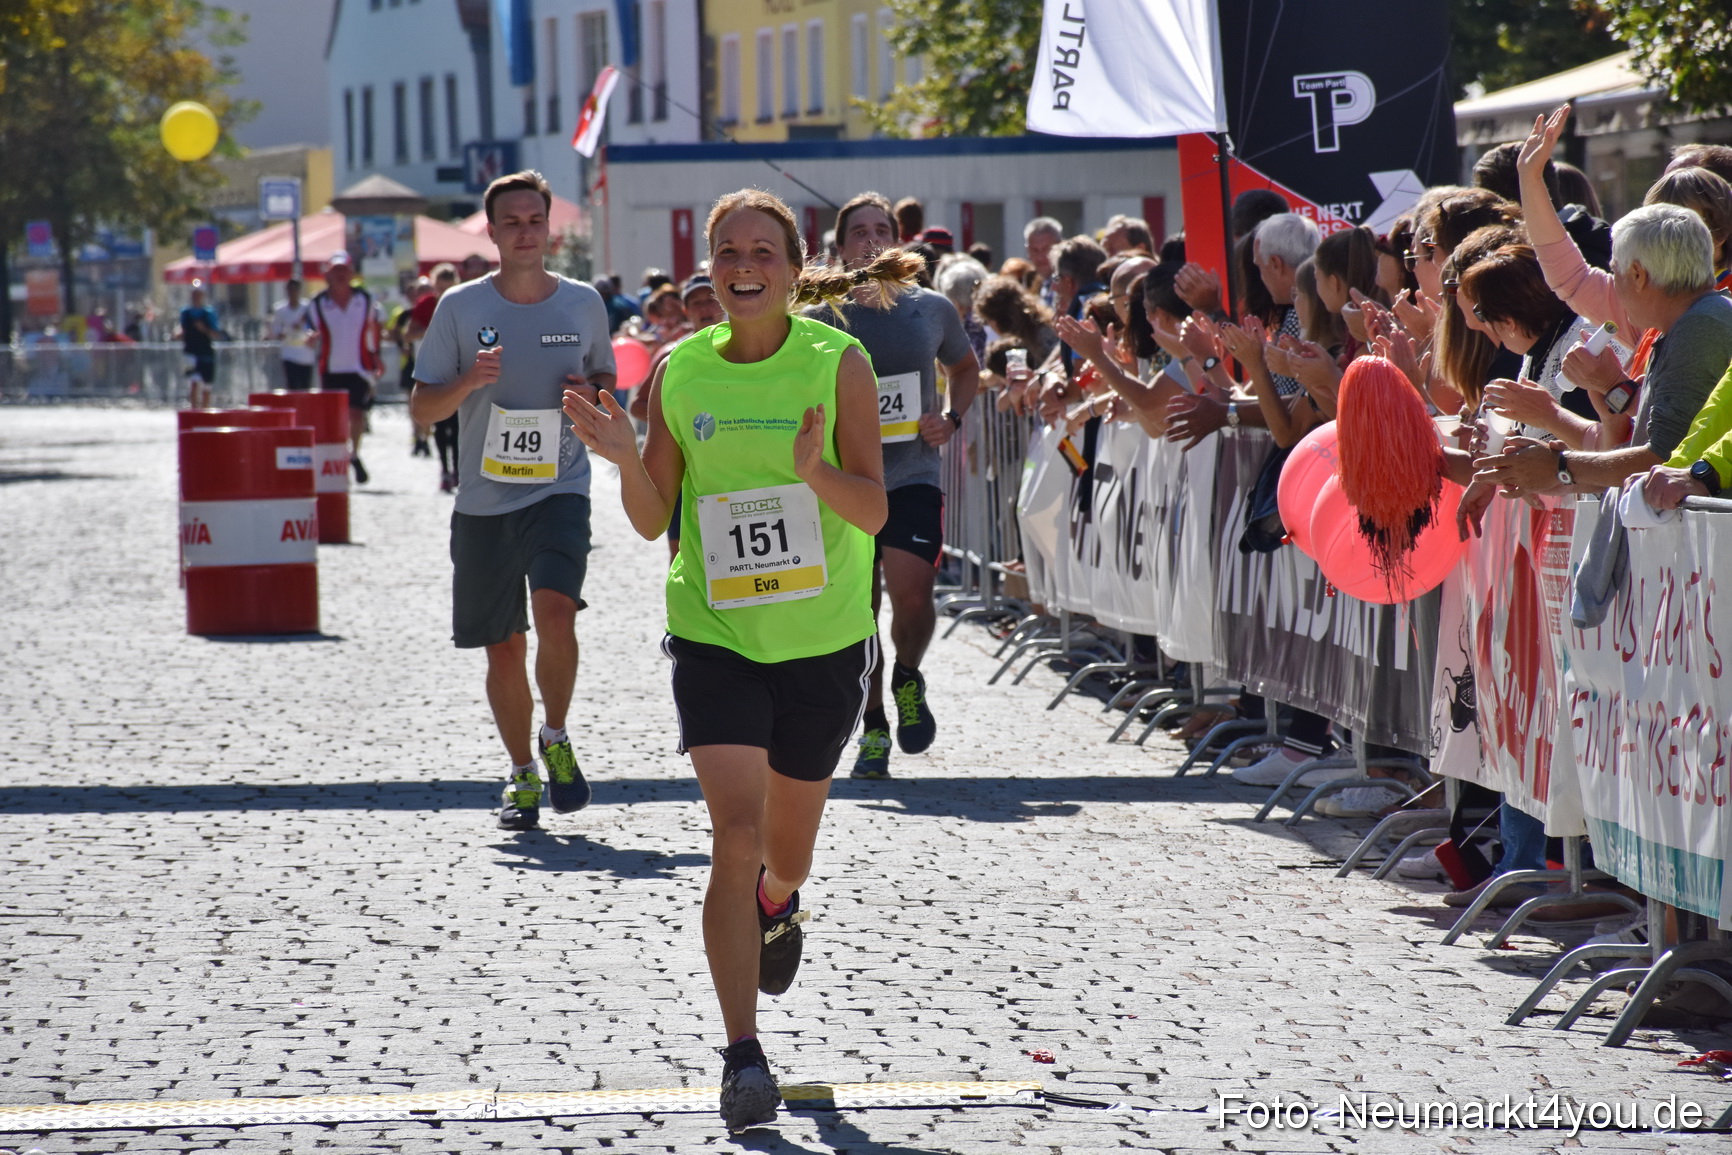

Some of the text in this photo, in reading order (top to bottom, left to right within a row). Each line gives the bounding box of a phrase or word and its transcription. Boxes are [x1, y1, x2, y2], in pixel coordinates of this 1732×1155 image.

[1300, 81, 1324, 90] Team
[1290, 201, 1364, 222] HE NEXT
[541, 334, 580, 344] BOCK
[505, 416, 539, 425] BOCK
[500, 431, 541, 453] 149
[502, 466, 534, 476] Martin
[730, 497, 782, 515] BOCK
[729, 518, 788, 559] 151
[729, 559, 790, 572] PARTL Neumarkt
[754, 578, 779, 592] Eva
